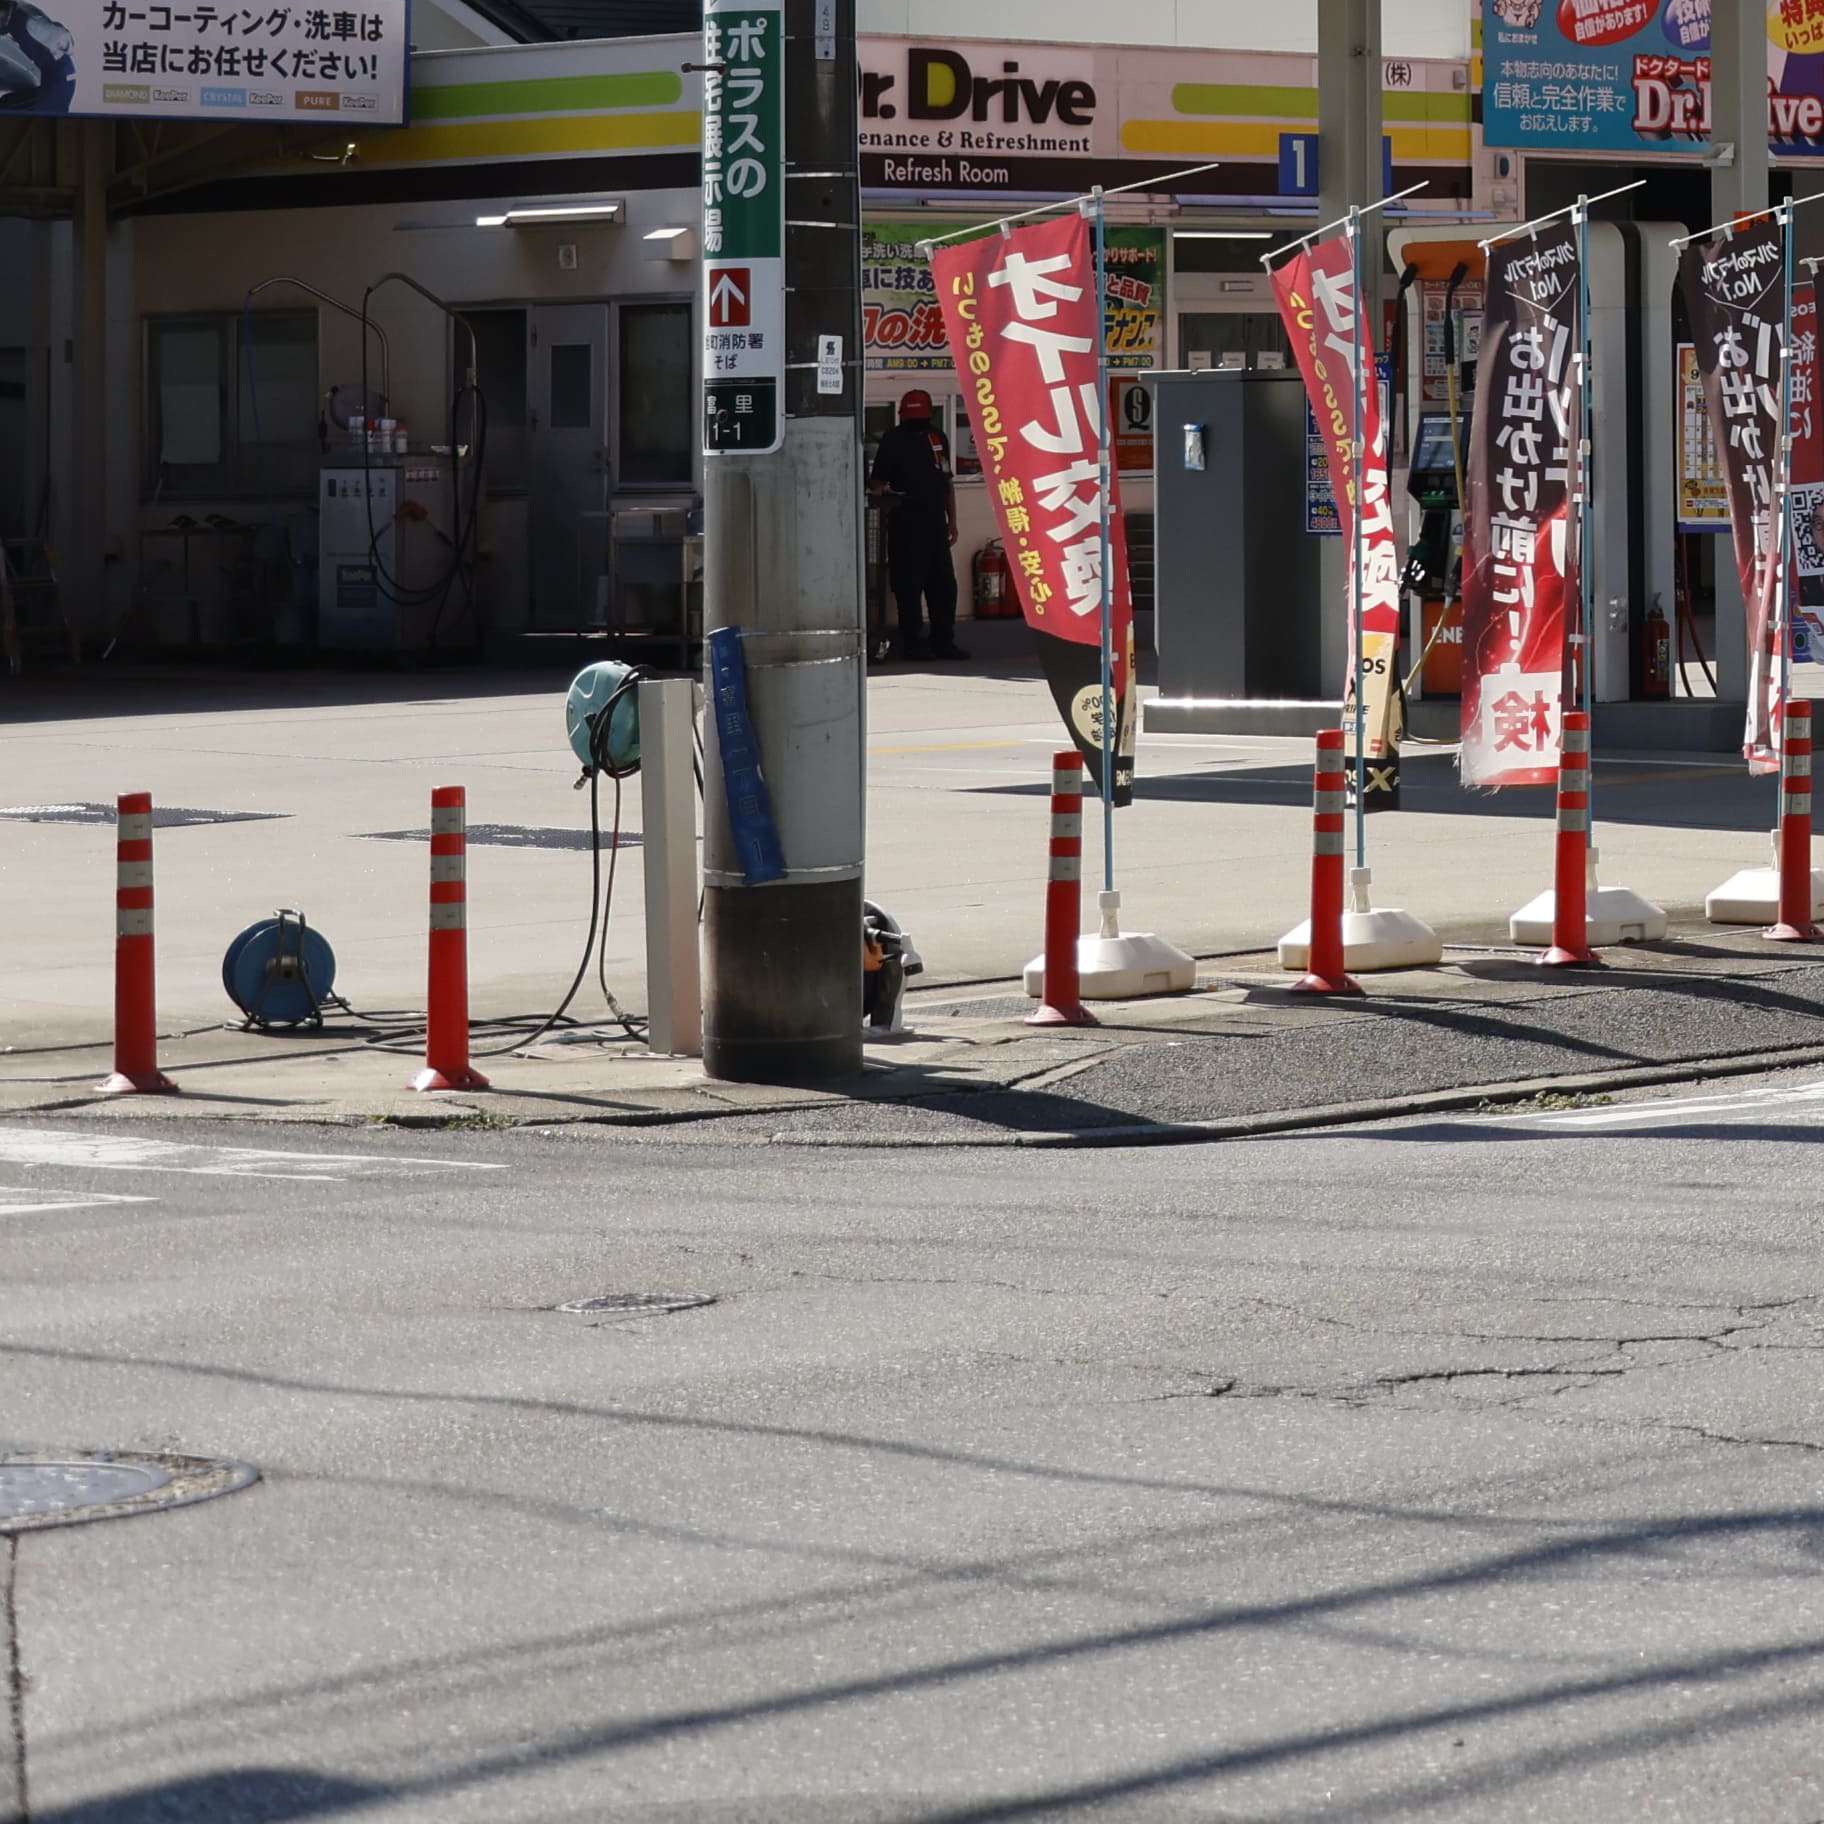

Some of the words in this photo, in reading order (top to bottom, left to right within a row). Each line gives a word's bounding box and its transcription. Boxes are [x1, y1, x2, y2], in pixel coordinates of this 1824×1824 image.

[102, 0, 384, 42] カーコーティング・洗車は
[1574, 3, 1648, 42] 自信があります!
[102, 40, 378, 80] 当店にお任せください!
[1500, 60, 1619, 82] 本物志向のあなたに!
[1385, 61, 1413, 86] (株)
[105, 88, 148, 100] DIAMOND
[152, 89, 189, 102] KeePer
[250, 92, 284, 106] KeePer
[858, 61, 897, 120] r.
[907, 47, 1097, 126] Drive
[1493, 82, 1627, 113] 信頼と完全作業で
[303, 96, 332, 107] PURE
[342, 96, 377, 109] KeePer
[726, 17, 767, 199] ポラスの
[1519, 115, 1599, 133] お応えします。
[859, 131, 930, 147] enance
[937, 131, 953, 148] &
[960, 131, 1091, 152] Refreshment
[885, 158, 952, 183] Refresh
[959, 161, 1009, 184] Room
[1293, 140, 1305, 188] 1
[714, 354, 738, 370] そば
[713, 421, 741, 441] 1-1
